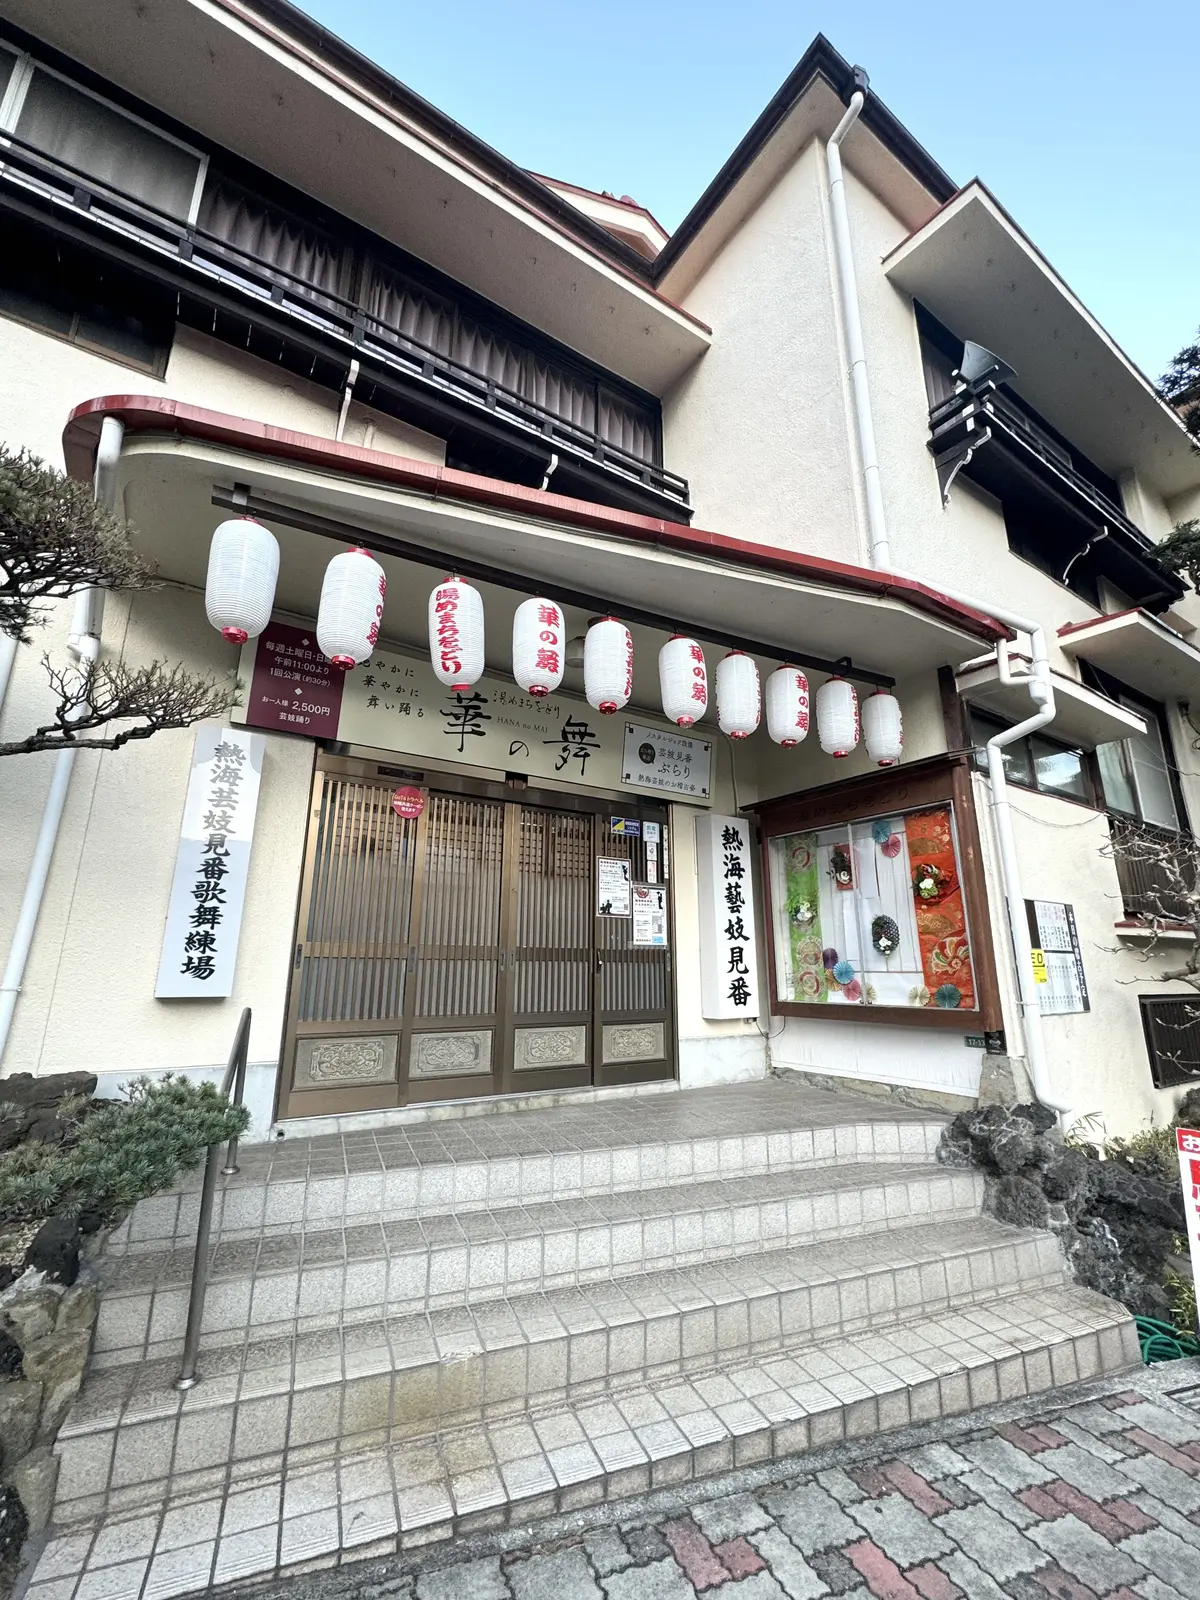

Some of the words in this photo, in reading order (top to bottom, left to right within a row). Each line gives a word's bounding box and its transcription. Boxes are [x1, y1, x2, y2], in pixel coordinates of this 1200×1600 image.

[537, 604, 560, 675] 華の舞
[274, 656, 330, 675] 午前11:00より
[688, 644, 707, 705] 華の舞
[362, 675, 420, 697] 華やかに
[261, 695, 289, 707] お一人様
[291, 700, 331, 716] 2,500円
[366, 694, 425, 718] 舞い踊る
[795, 674, 809, 731] 華の舞
[497, 716, 521, 728] HANA
[533, 725, 549, 734] MAI
[657, 762, 691, 779] ぶらり
[179, 740, 248, 981] 熱海芸妓見番歌舞練場
[720, 824, 752, 1007] 熱海藝妓見番
